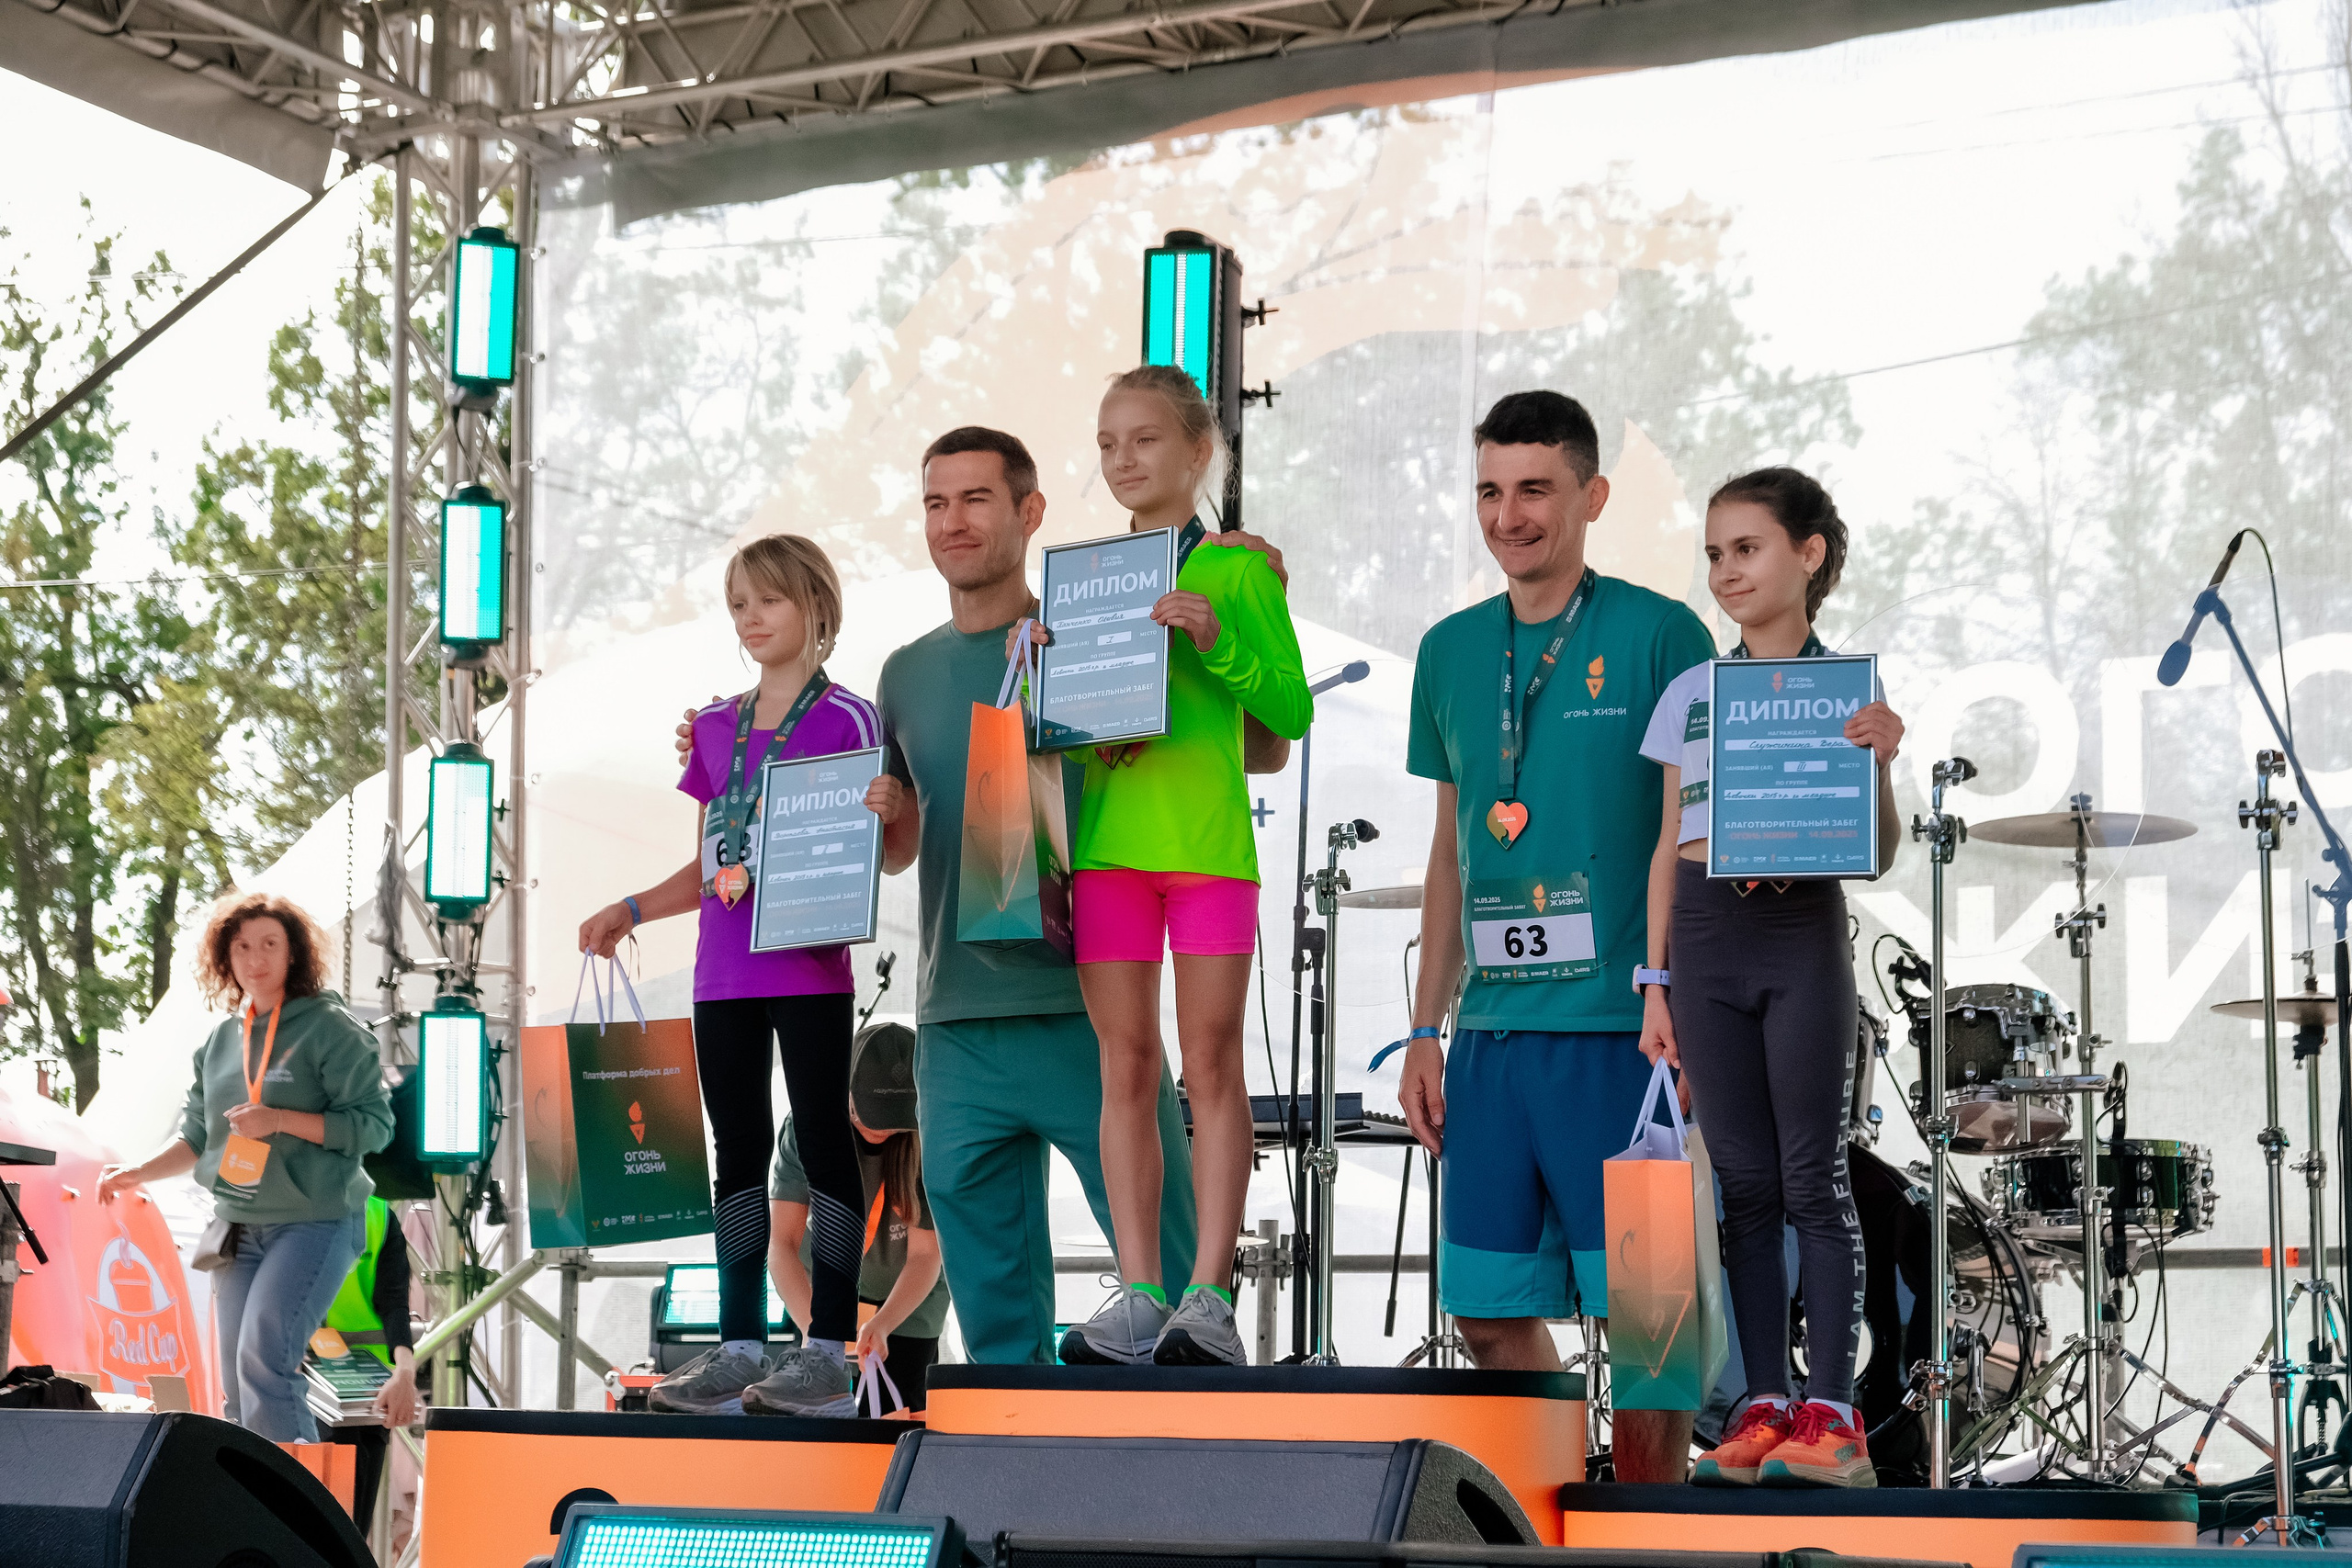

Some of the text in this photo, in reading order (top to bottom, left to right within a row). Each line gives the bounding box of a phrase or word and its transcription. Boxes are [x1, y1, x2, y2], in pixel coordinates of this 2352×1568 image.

[1054, 570, 1158, 607] ДИПЛОМ
[1050, 682, 1154, 705] БЛАГОТВОРИТЕЛЬНЫЙ ЗАБЕГ
[1564, 707, 1627, 718] ОГОНЬ ЖИЗНИ
[1725, 697, 1859, 725] ДИПЛОМ
[1820, 739, 1849, 750] Вера
[773, 785, 870, 818] ДИПЛОМ
[1725, 818, 1858, 829] БЛАГОТВОРИТЕЛЬНЫЙ ЗАБЕГ
[766, 891, 862, 908] БЛАГОТВОРИТЕЛЬНЫЙ ЗАБЕГ
[1550, 897, 1583, 907] ЖИЗНИ
[1551, 890, 1580, 899] ОГОНЬ
[1504, 924, 1548, 959] 63
[582, 1067, 680, 1080] Платформа добрых дел
[624, 1150, 662, 1162] ОГОНЬ
[623, 1161, 666, 1176] ЖИЗНИ
[1833, 1050, 1866, 1359] I AM THE FUTURE
[108, 1318, 150, 1366] Red
